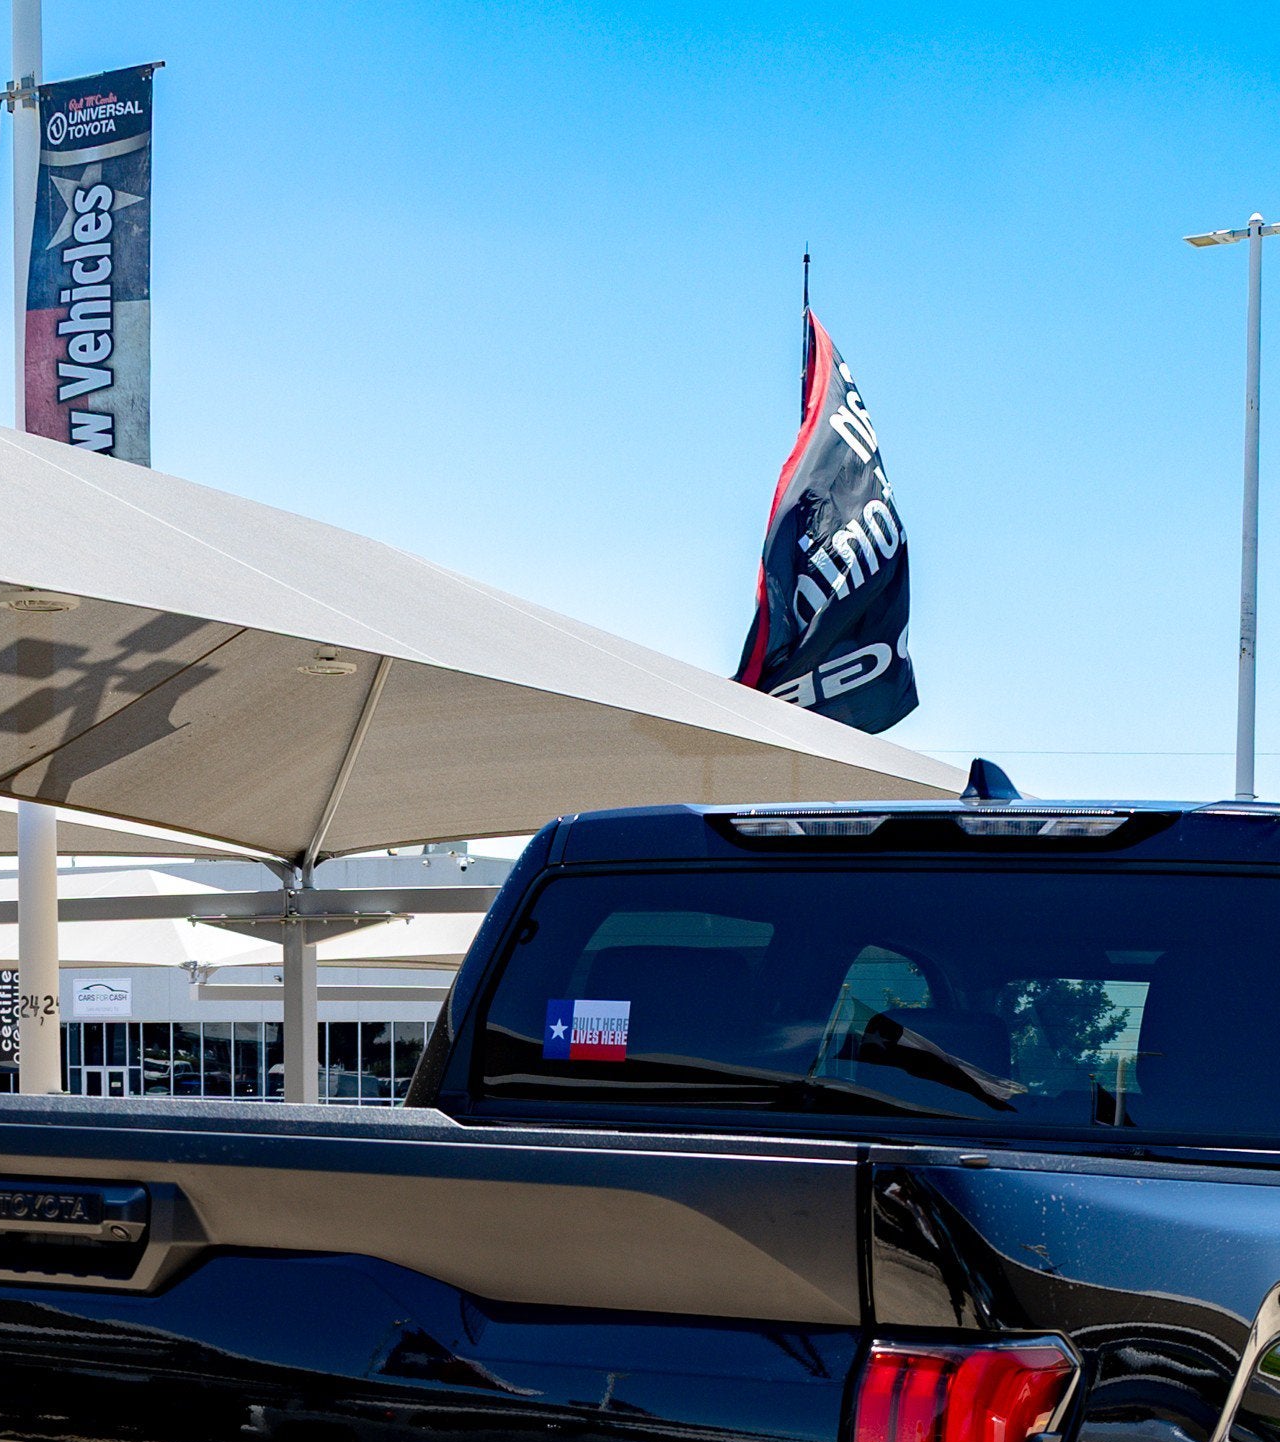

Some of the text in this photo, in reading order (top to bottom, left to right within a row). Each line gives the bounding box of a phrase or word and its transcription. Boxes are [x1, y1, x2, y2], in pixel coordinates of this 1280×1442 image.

[68, 100, 143, 125] UNIVERSAL
[67, 118, 116, 140] TOYOTA
[58, 183, 115, 402] Vehicles
[77, 993, 128, 1002] CARS FOR CASH
[573, 1016, 630, 1032] BUILT HERE
[571, 1029, 628, 1046] LIVES HERE
